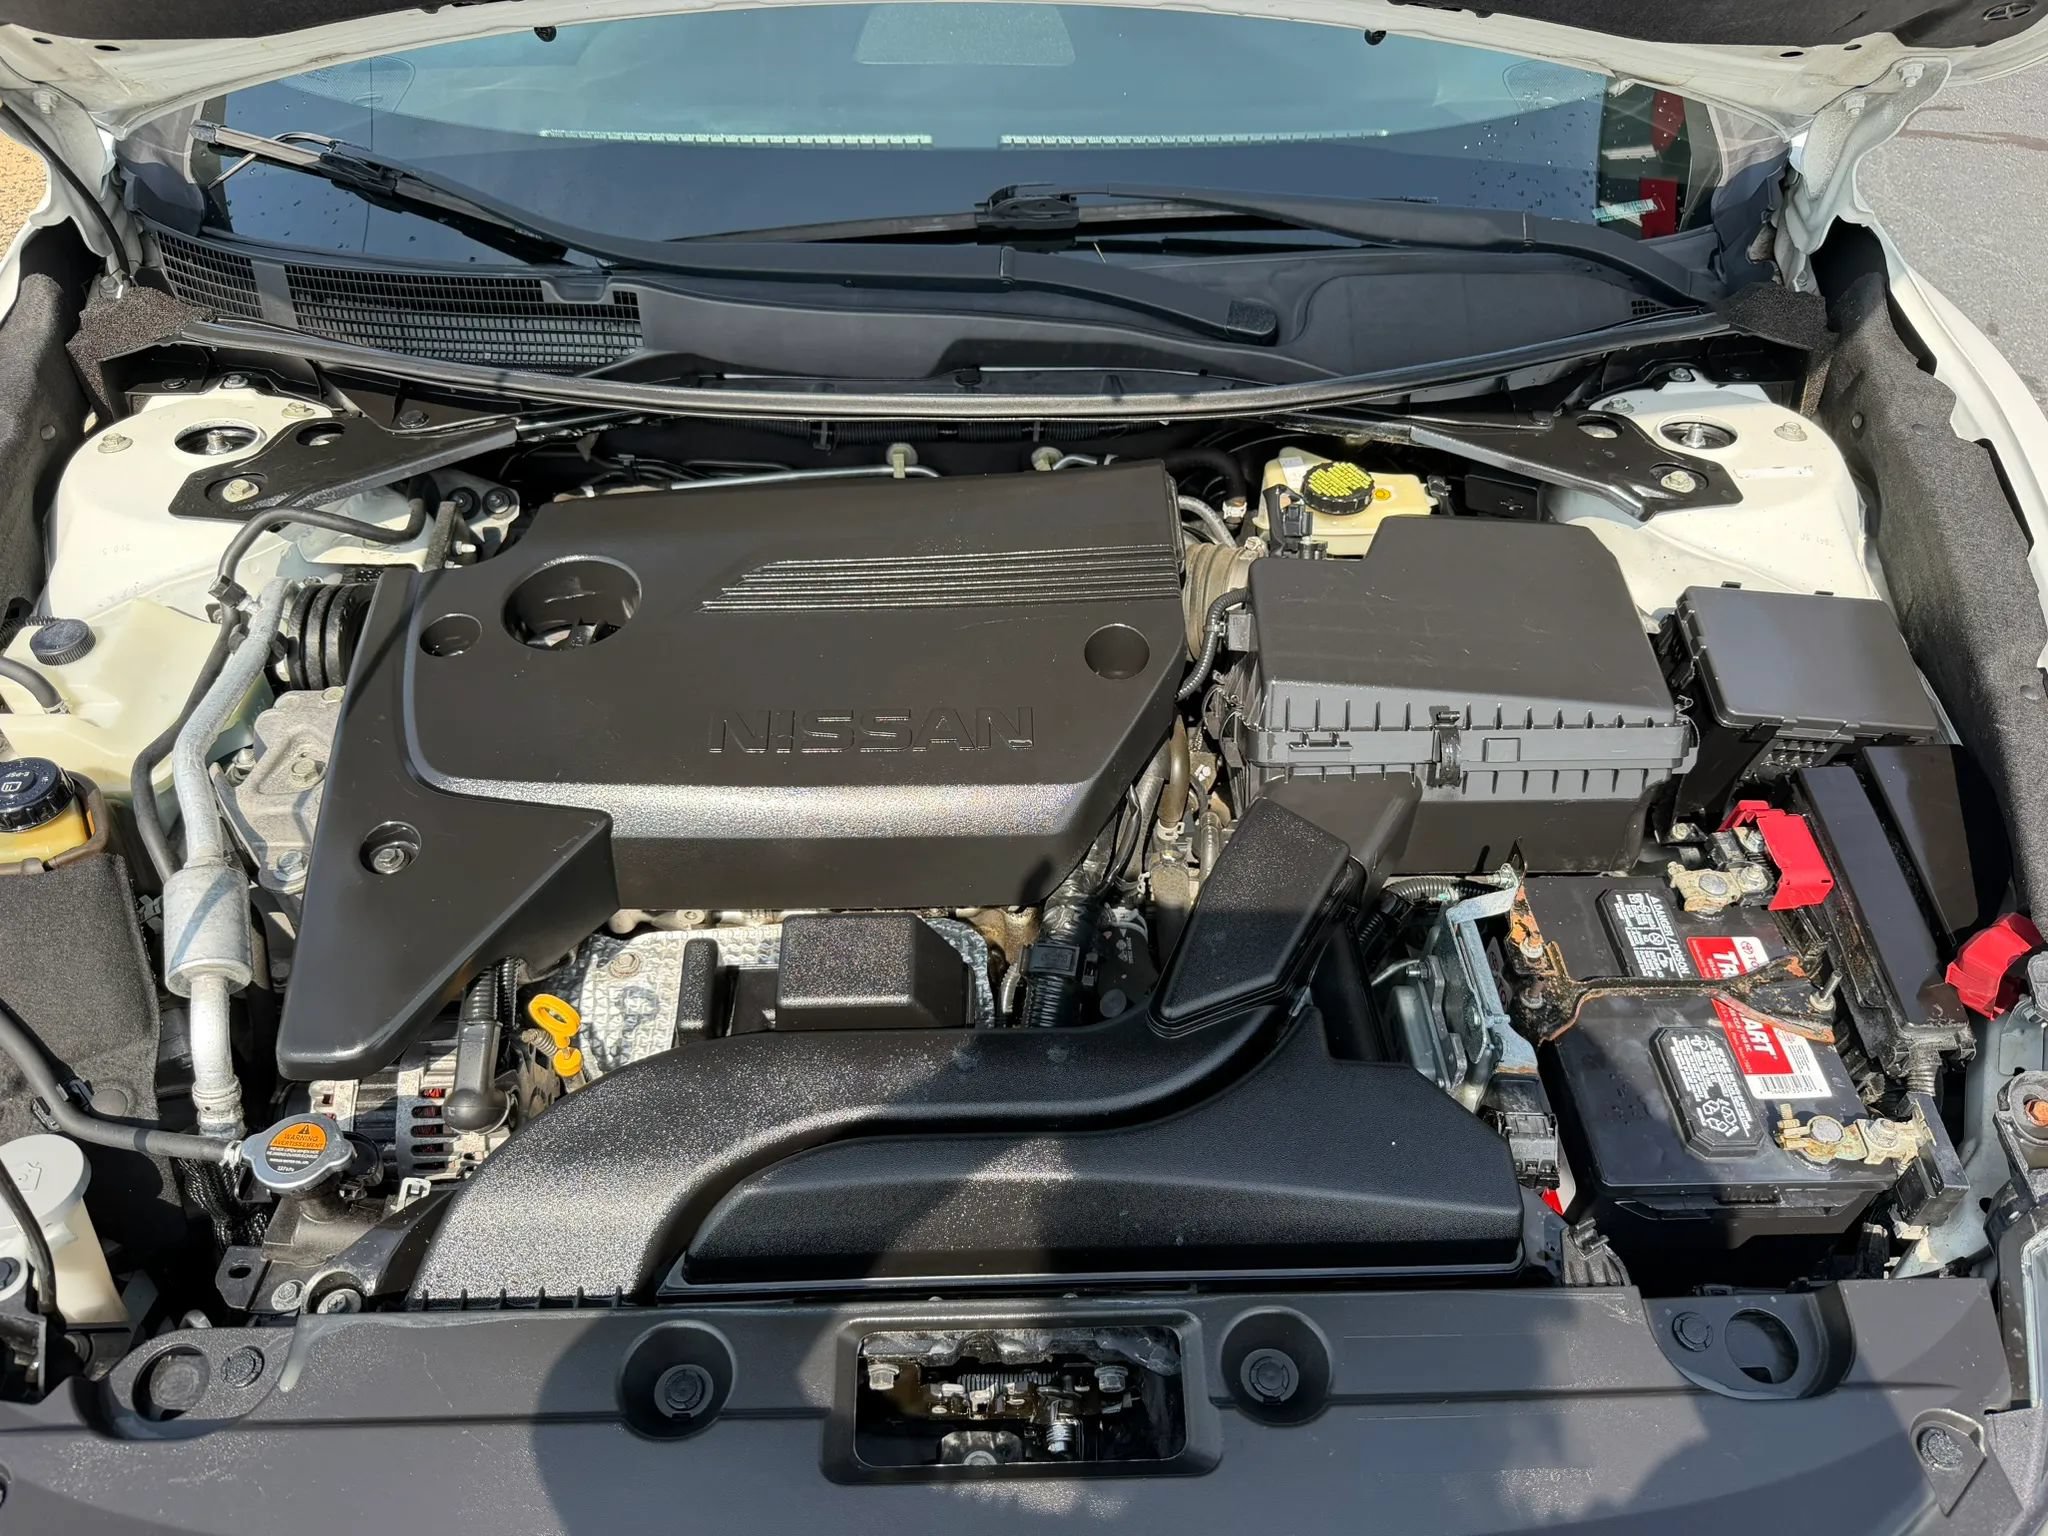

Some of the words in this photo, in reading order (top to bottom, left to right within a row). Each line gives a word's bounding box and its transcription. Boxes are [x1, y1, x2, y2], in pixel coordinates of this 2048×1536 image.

[707, 706, 1034, 753] NISSAN
[1653, 903, 1675, 937] DANGER
[1670, 943, 1690, 975] POISON
[1712, 950, 1740, 979] TR
[1739, 1015, 1777, 1059] ART
[284, 1133, 319, 1142] WARNING
